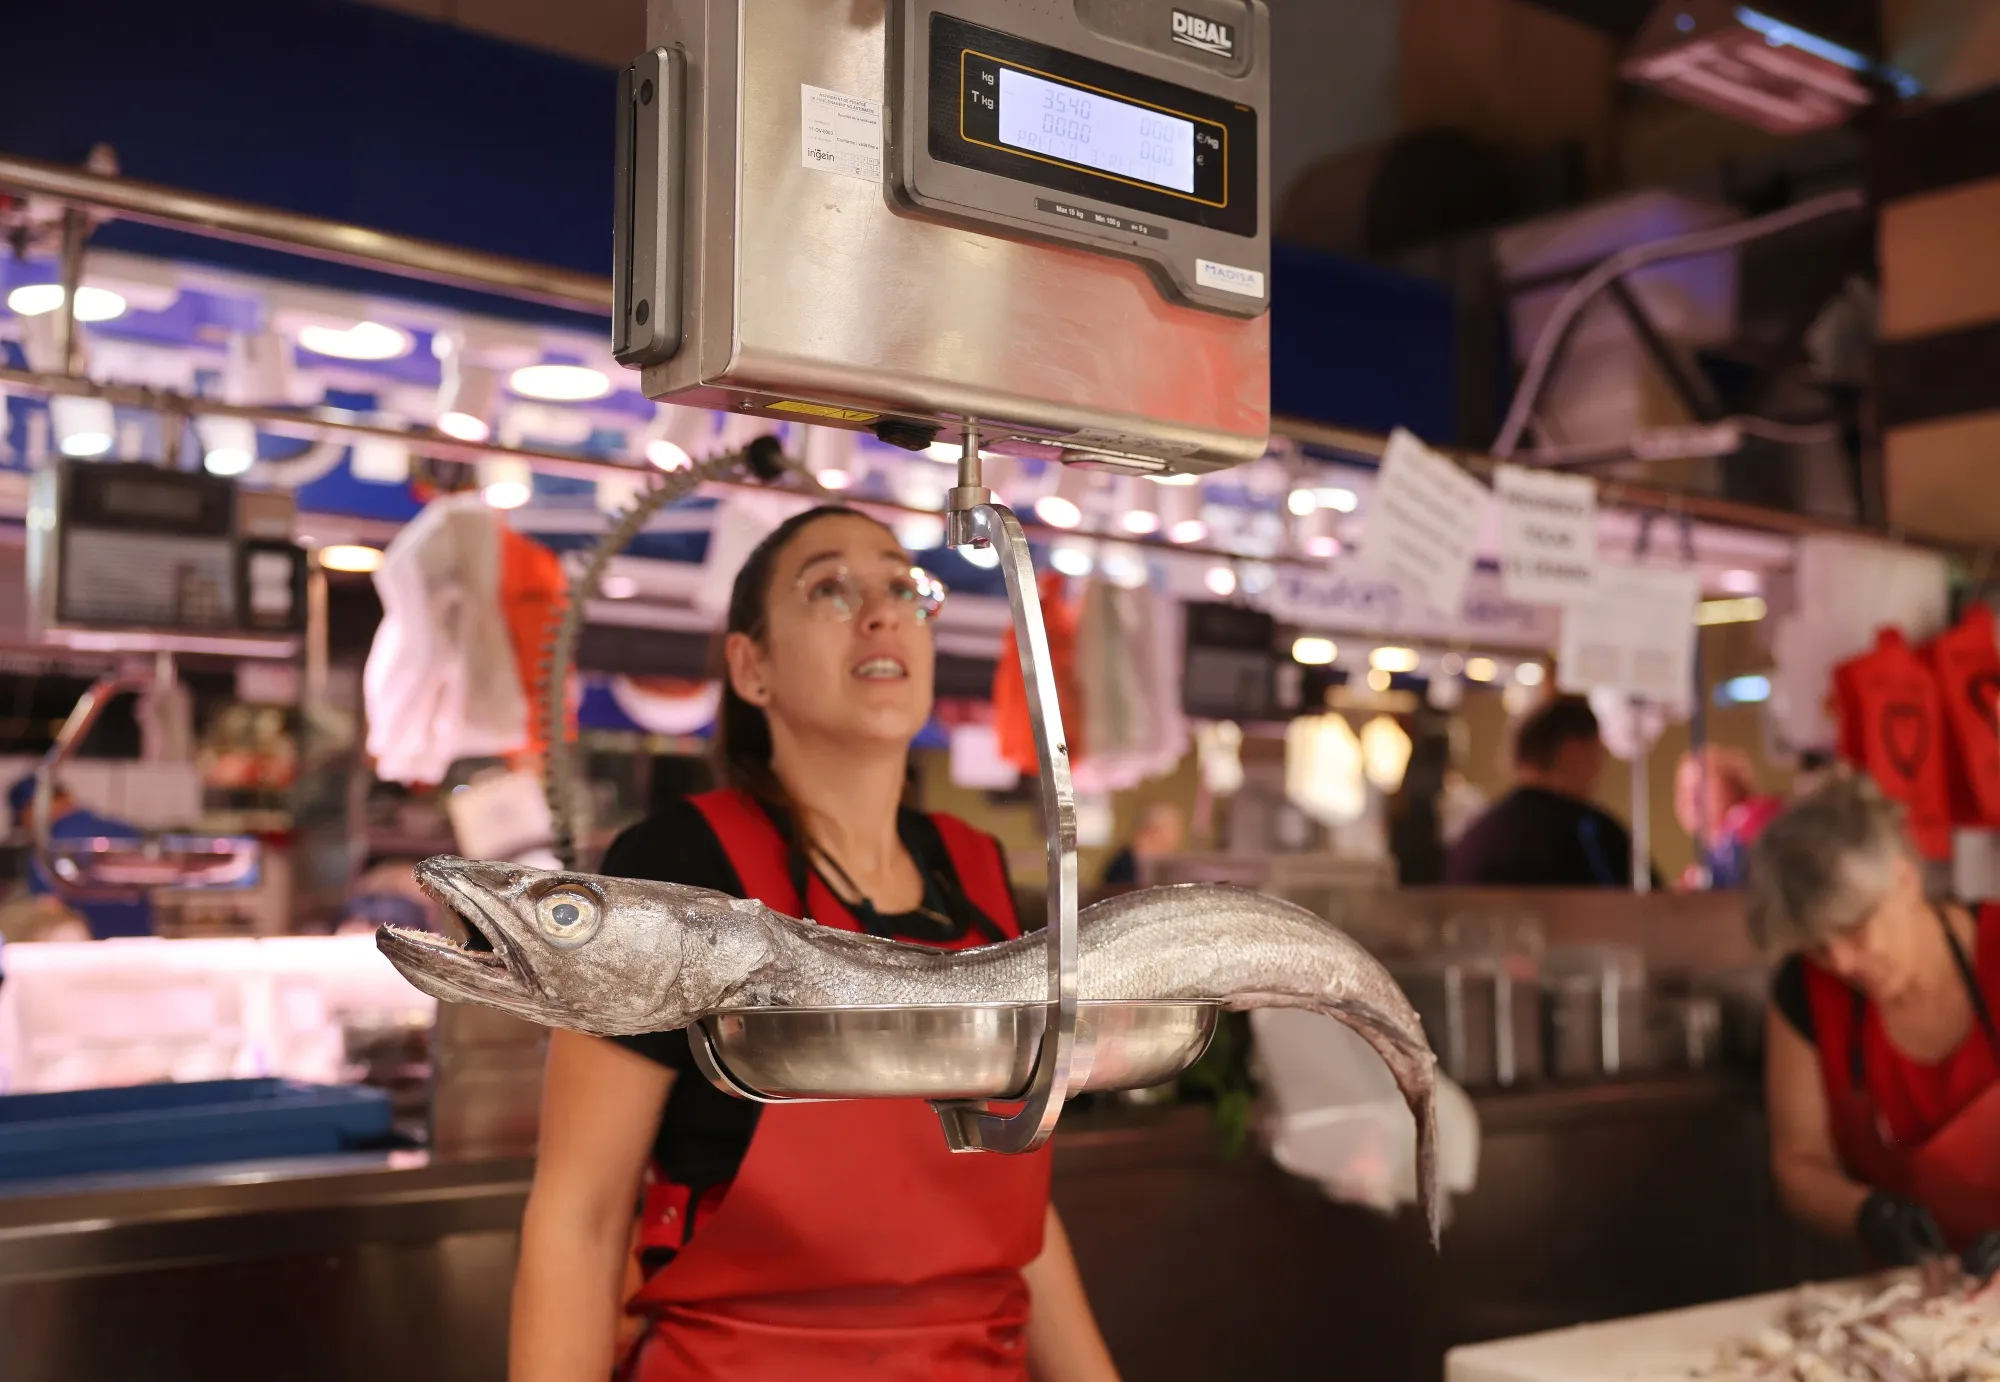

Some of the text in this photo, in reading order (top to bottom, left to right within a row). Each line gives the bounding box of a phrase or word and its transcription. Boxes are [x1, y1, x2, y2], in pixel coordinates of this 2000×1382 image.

[1172, 11, 1232, 48] DIBAL
[981, 70, 994, 86] kg
[971, 89, 994, 110] T kg
[1055, 205, 1084, 219] Max 15 kg
[1095, 214, 1106, 223] Min
